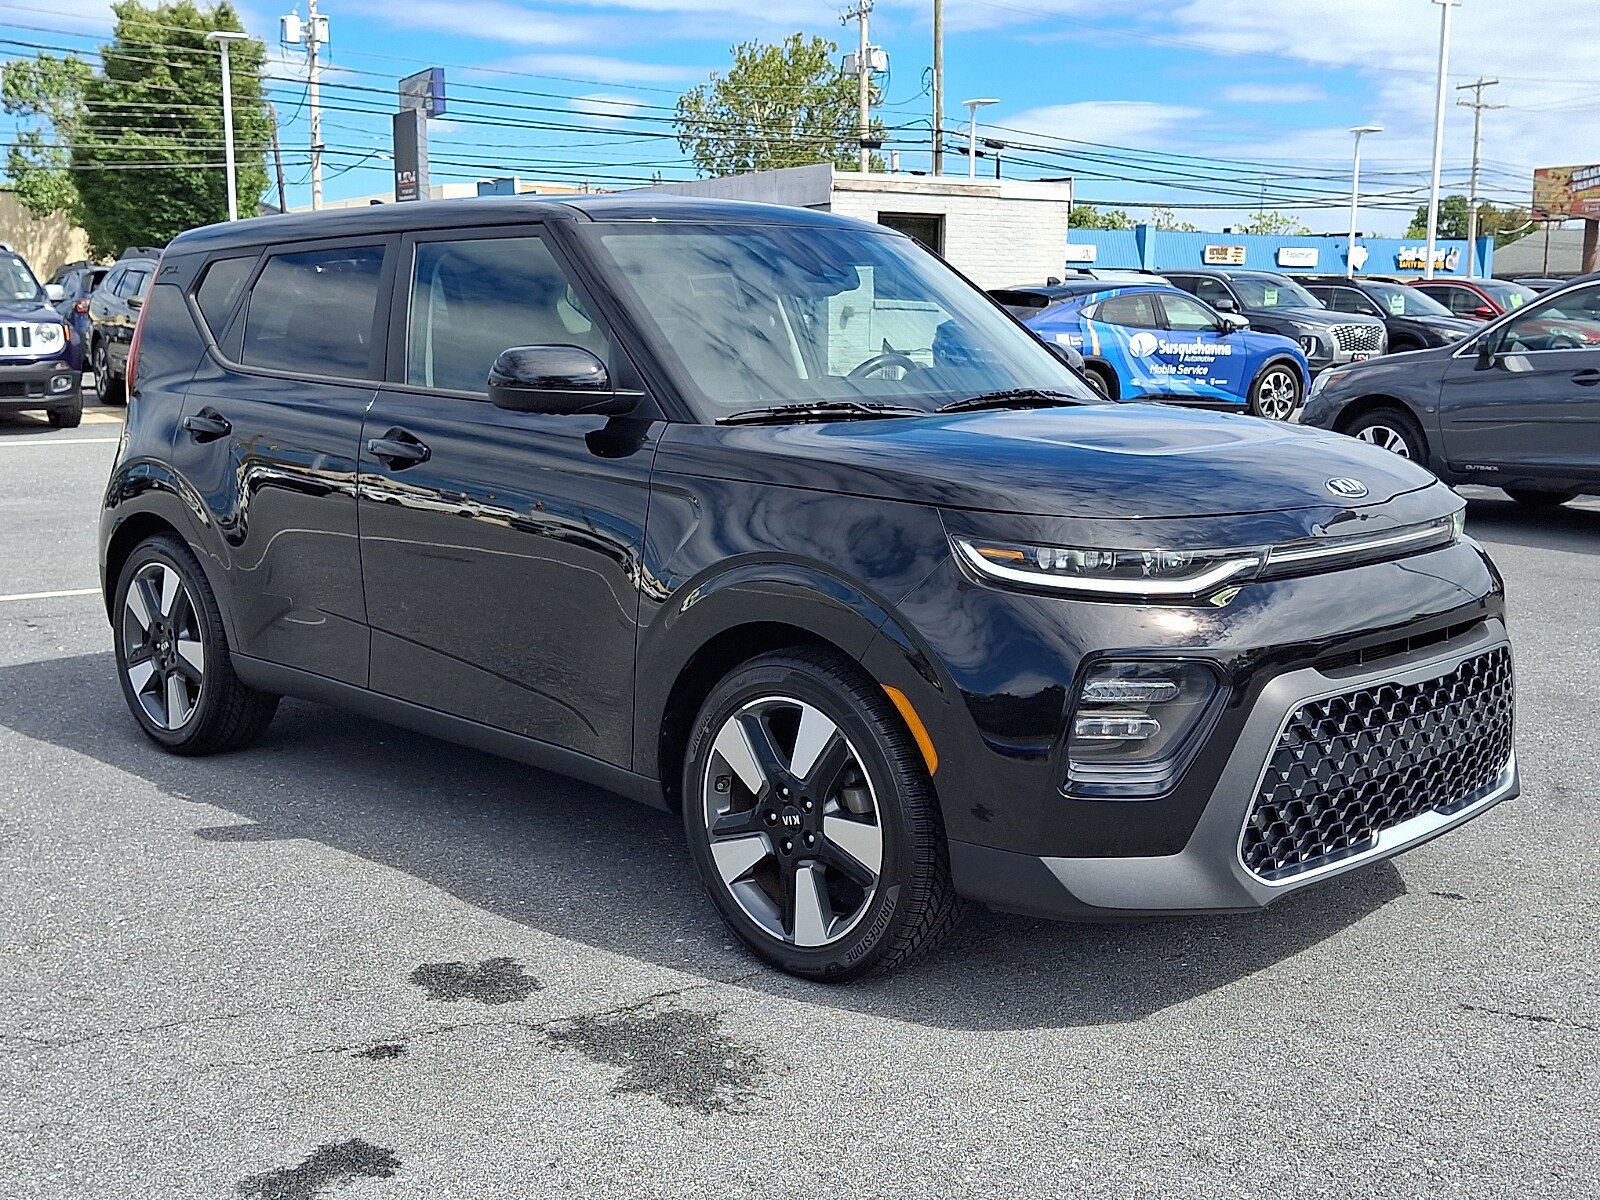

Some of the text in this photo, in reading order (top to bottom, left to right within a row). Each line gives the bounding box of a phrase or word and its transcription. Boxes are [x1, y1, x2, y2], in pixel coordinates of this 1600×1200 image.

[1158, 337, 1232, 362] Susquehanna
[1149, 364, 1209, 375] Mobile Service
[1465, 464, 1500, 472] OUTBACK
[845, 896, 895, 964] BRIDGESTONE
